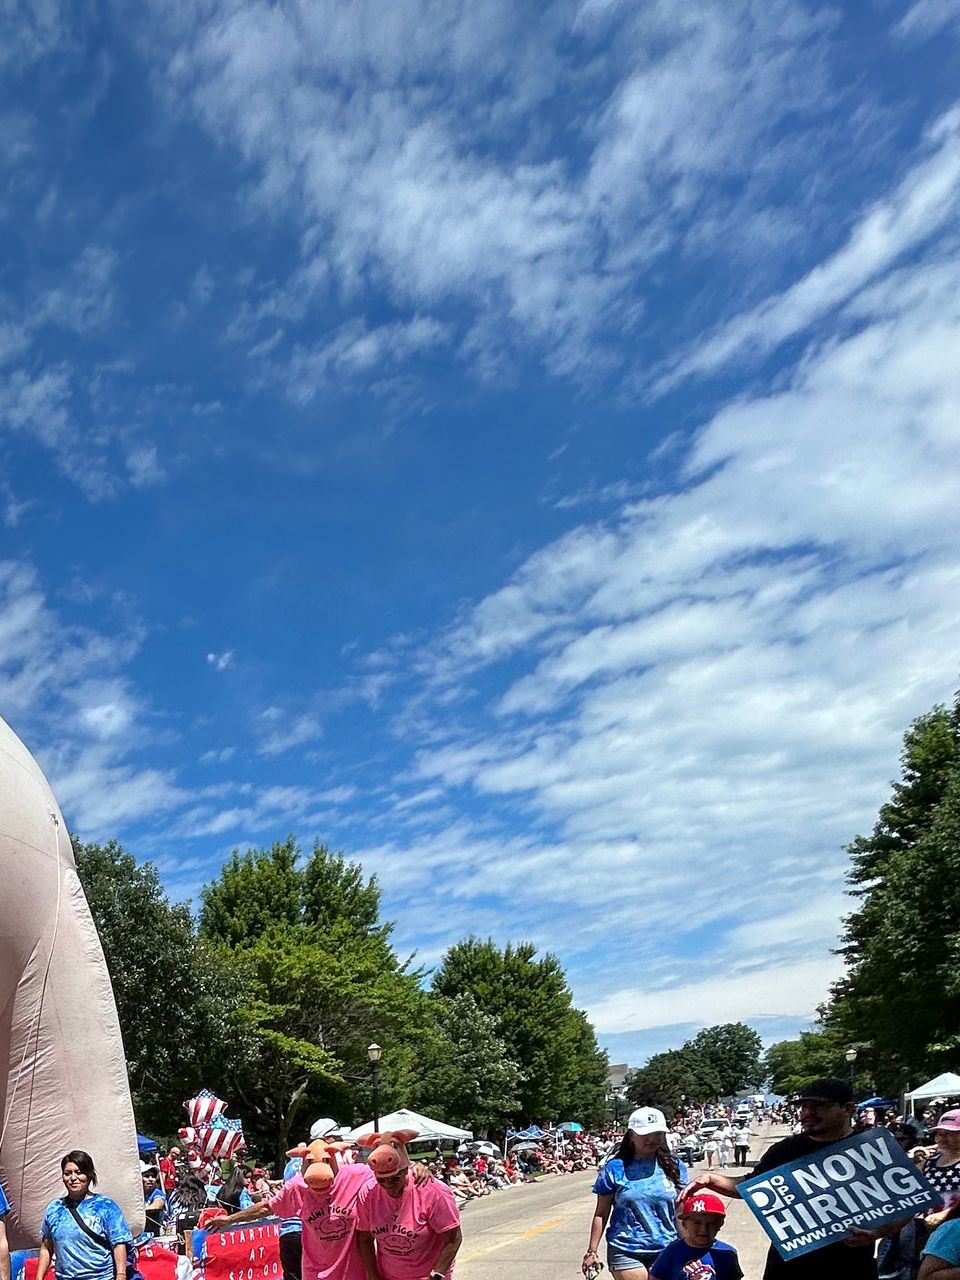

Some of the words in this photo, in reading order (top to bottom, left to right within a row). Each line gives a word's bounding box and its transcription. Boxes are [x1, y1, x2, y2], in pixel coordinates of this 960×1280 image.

[791, 1136, 893, 1195] NOW
[766, 1166, 923, 1241] HIRING
[781, 1190, 933, 1252] WWW.QPPINC.NET
[220, 1225, 279, 1246] STARTIN
[392, 1224, 420, 1239] PIGGY
[249, 1246, 265, 1261] AT
